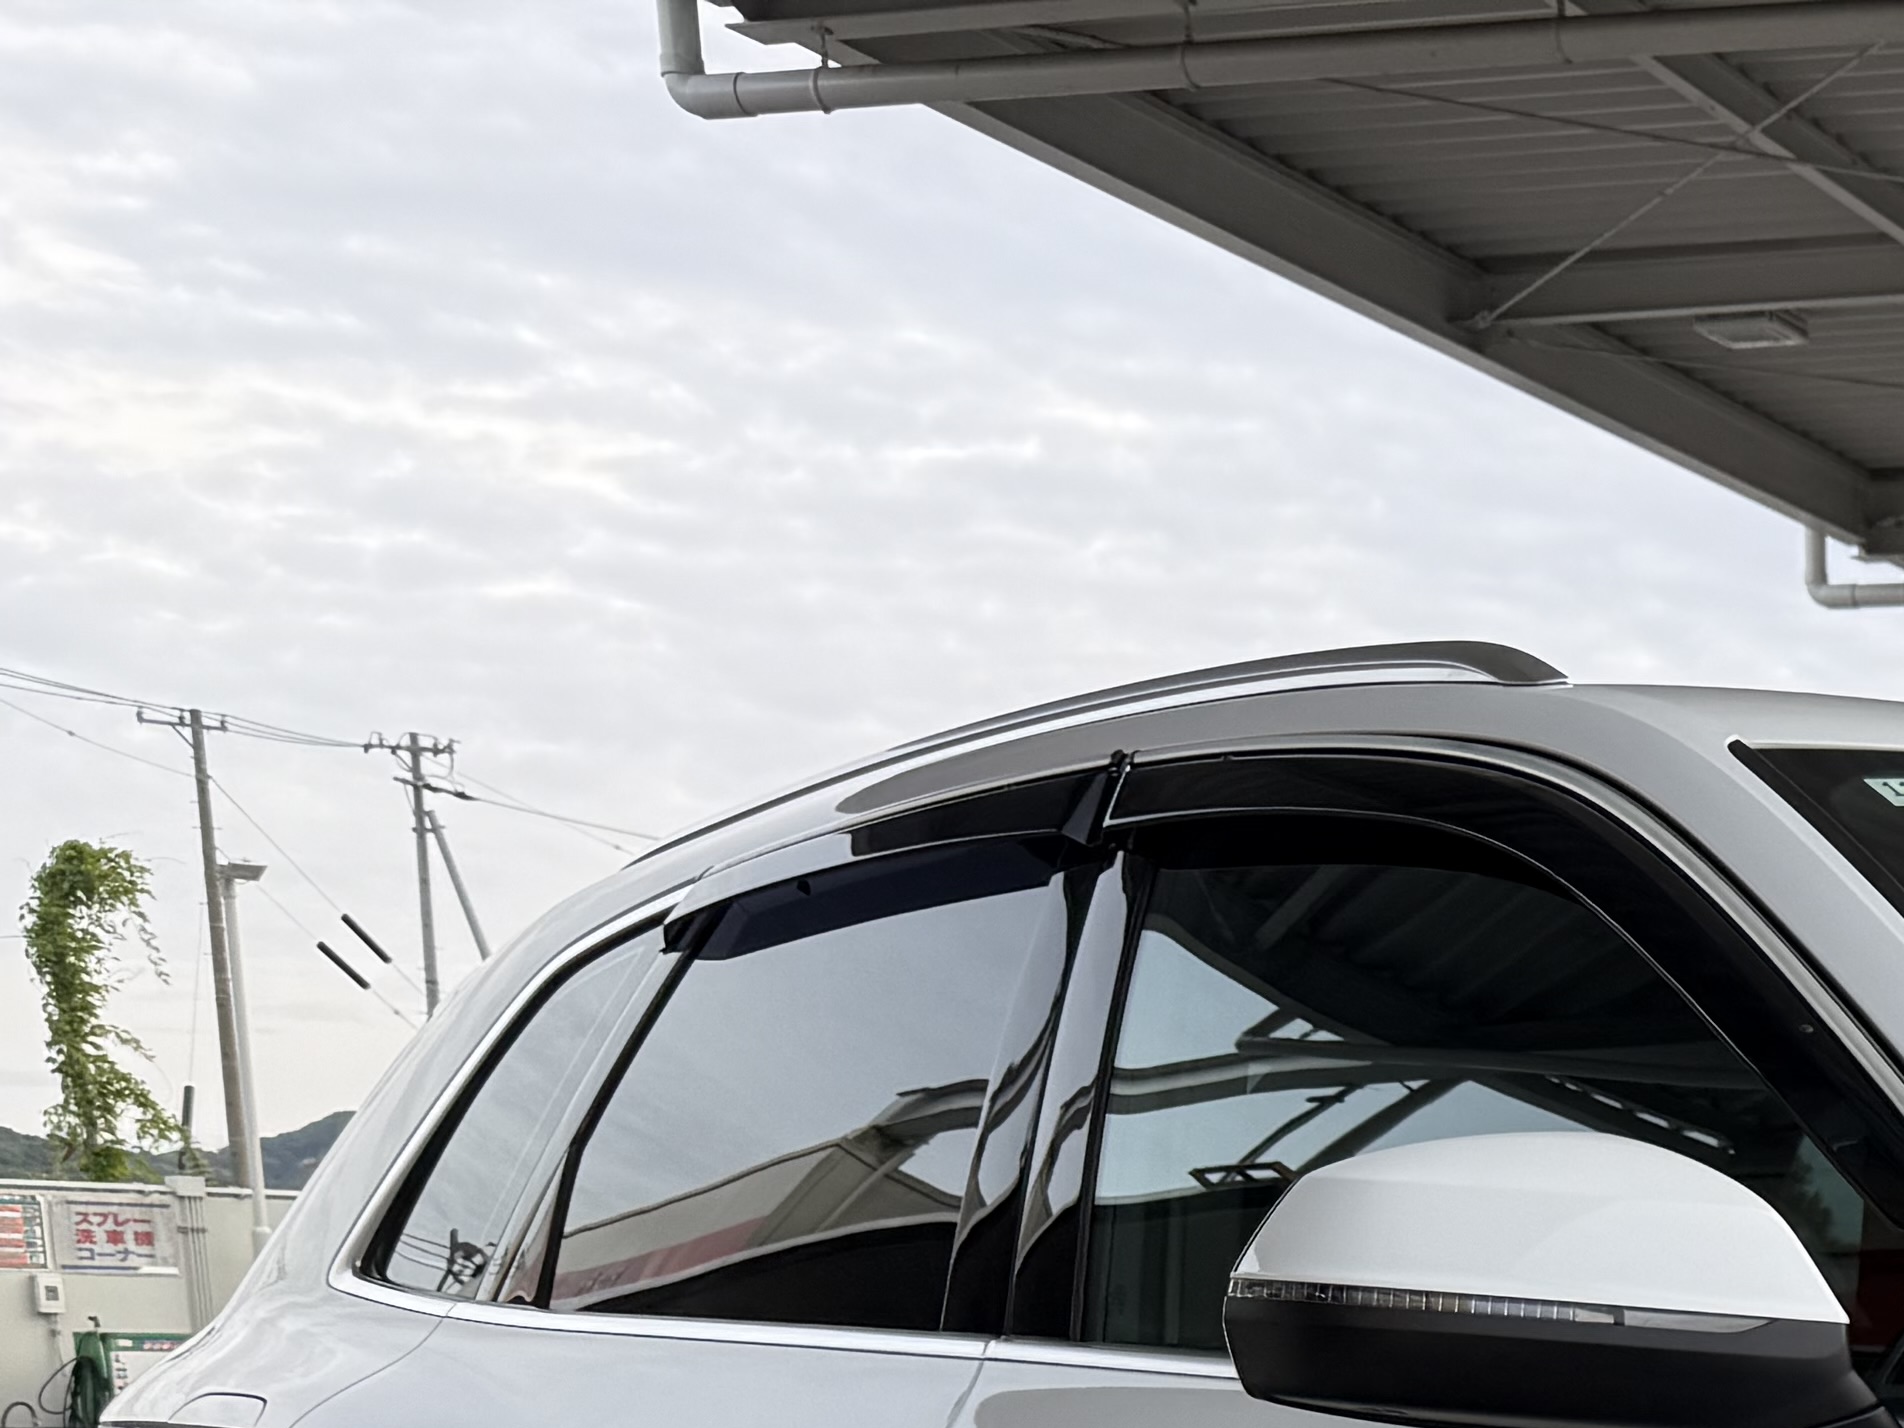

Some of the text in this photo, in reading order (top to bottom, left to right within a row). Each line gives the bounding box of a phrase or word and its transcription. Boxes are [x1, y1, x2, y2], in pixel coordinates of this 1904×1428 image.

[75, 1212, 152, 1227] スプレー
[76, 1248, 156, 1262] コーナー
